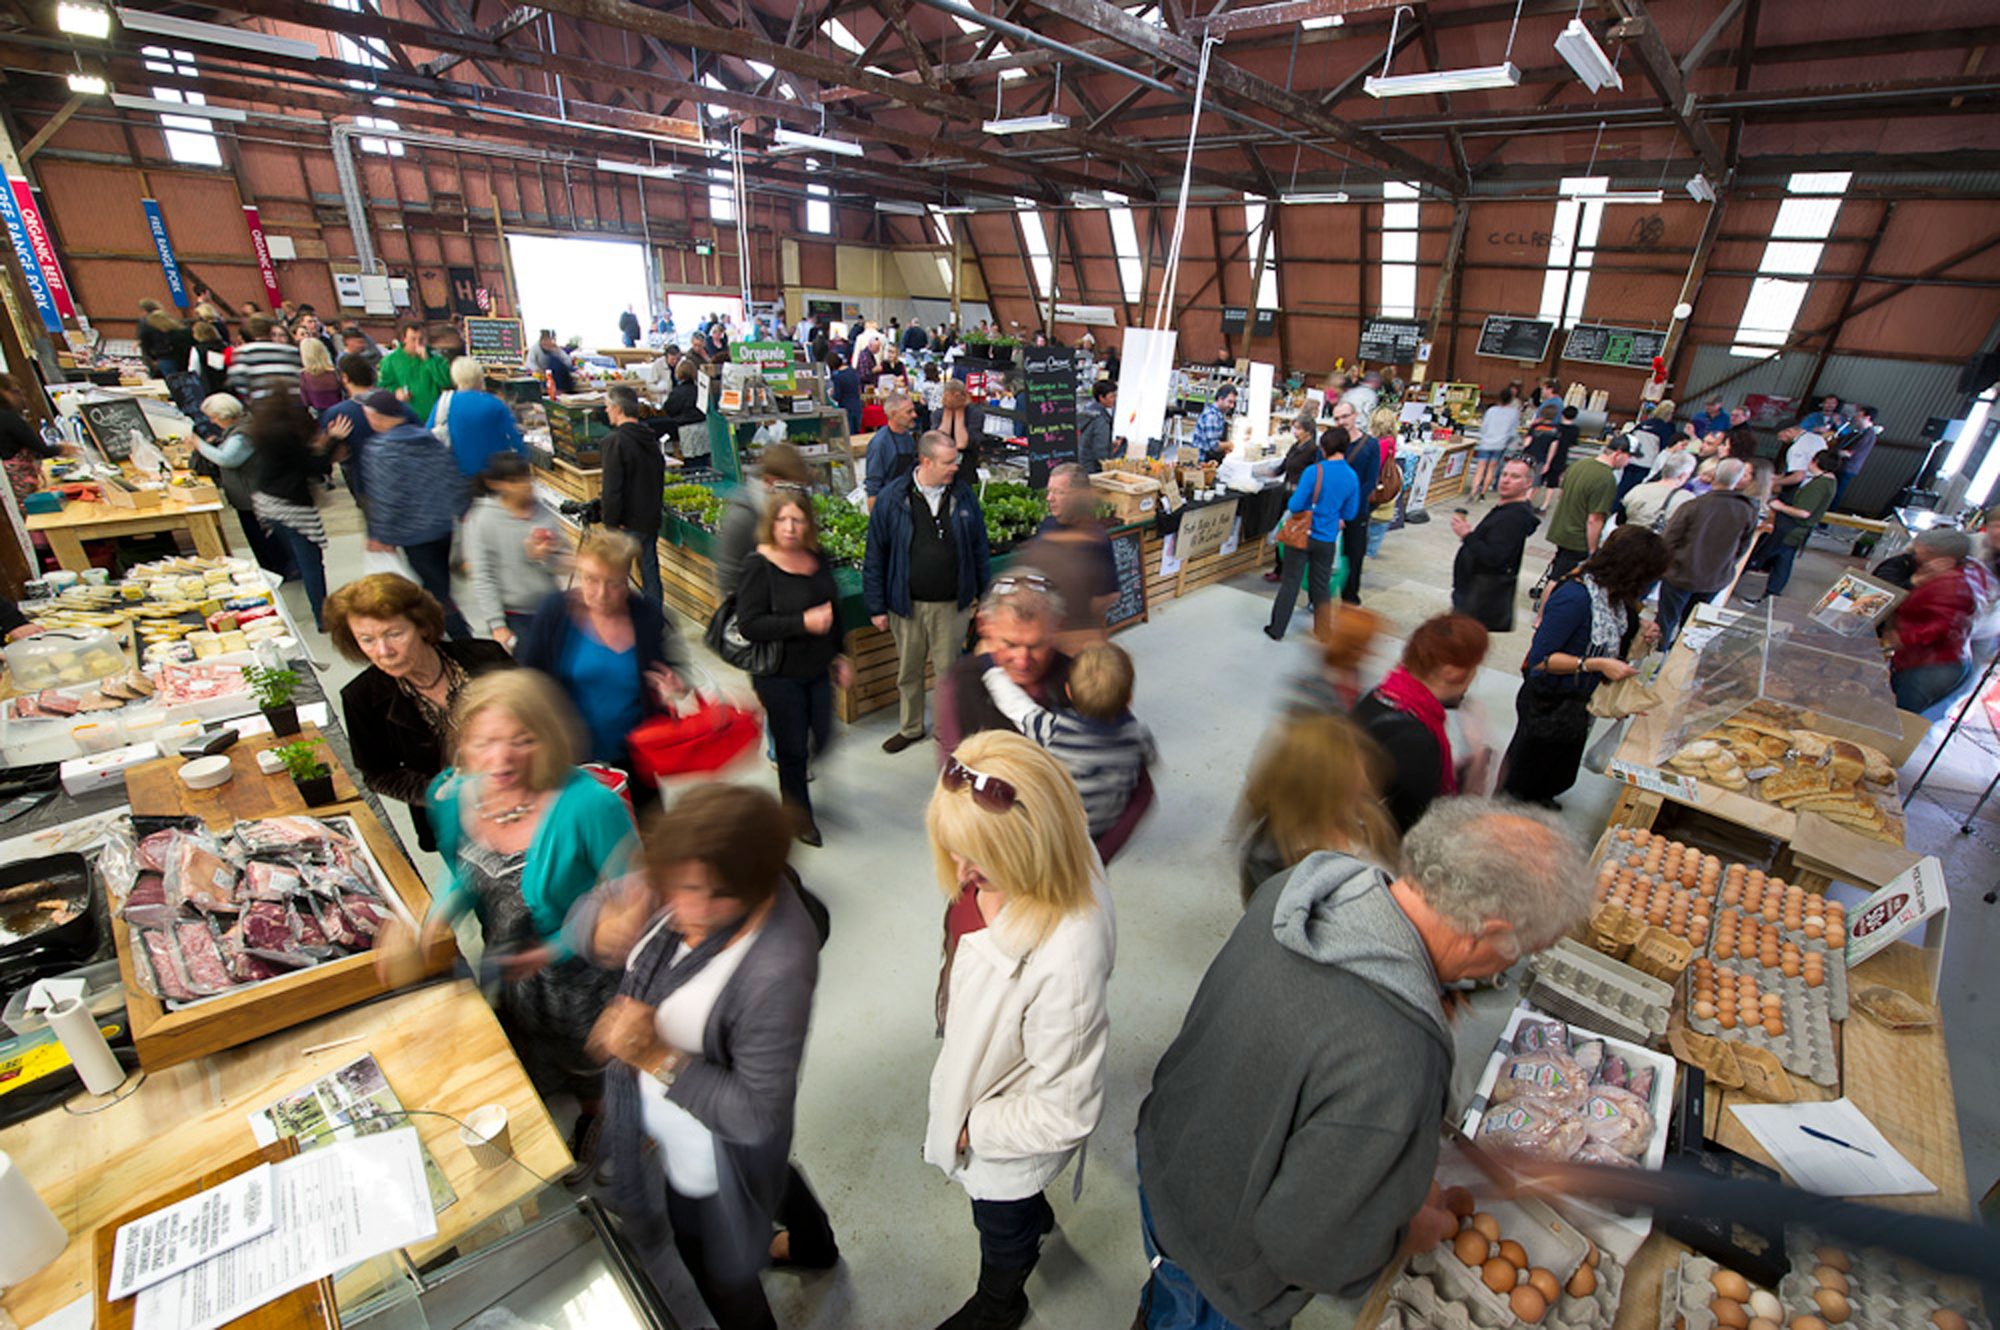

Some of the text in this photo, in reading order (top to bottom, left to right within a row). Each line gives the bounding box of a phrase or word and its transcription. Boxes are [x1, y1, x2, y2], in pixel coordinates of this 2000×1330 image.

[8, 222, 35, 271] RANGE
[26, 274, 50, 310] PORK
[21, 208, 62, 290] ORGANIC BEEF
[150, 215, 183, 293] FREE RANGE PORK
[251, 229, 277, 289] ORGANIC BEEF
[739, 345, 786, 361] Organic
